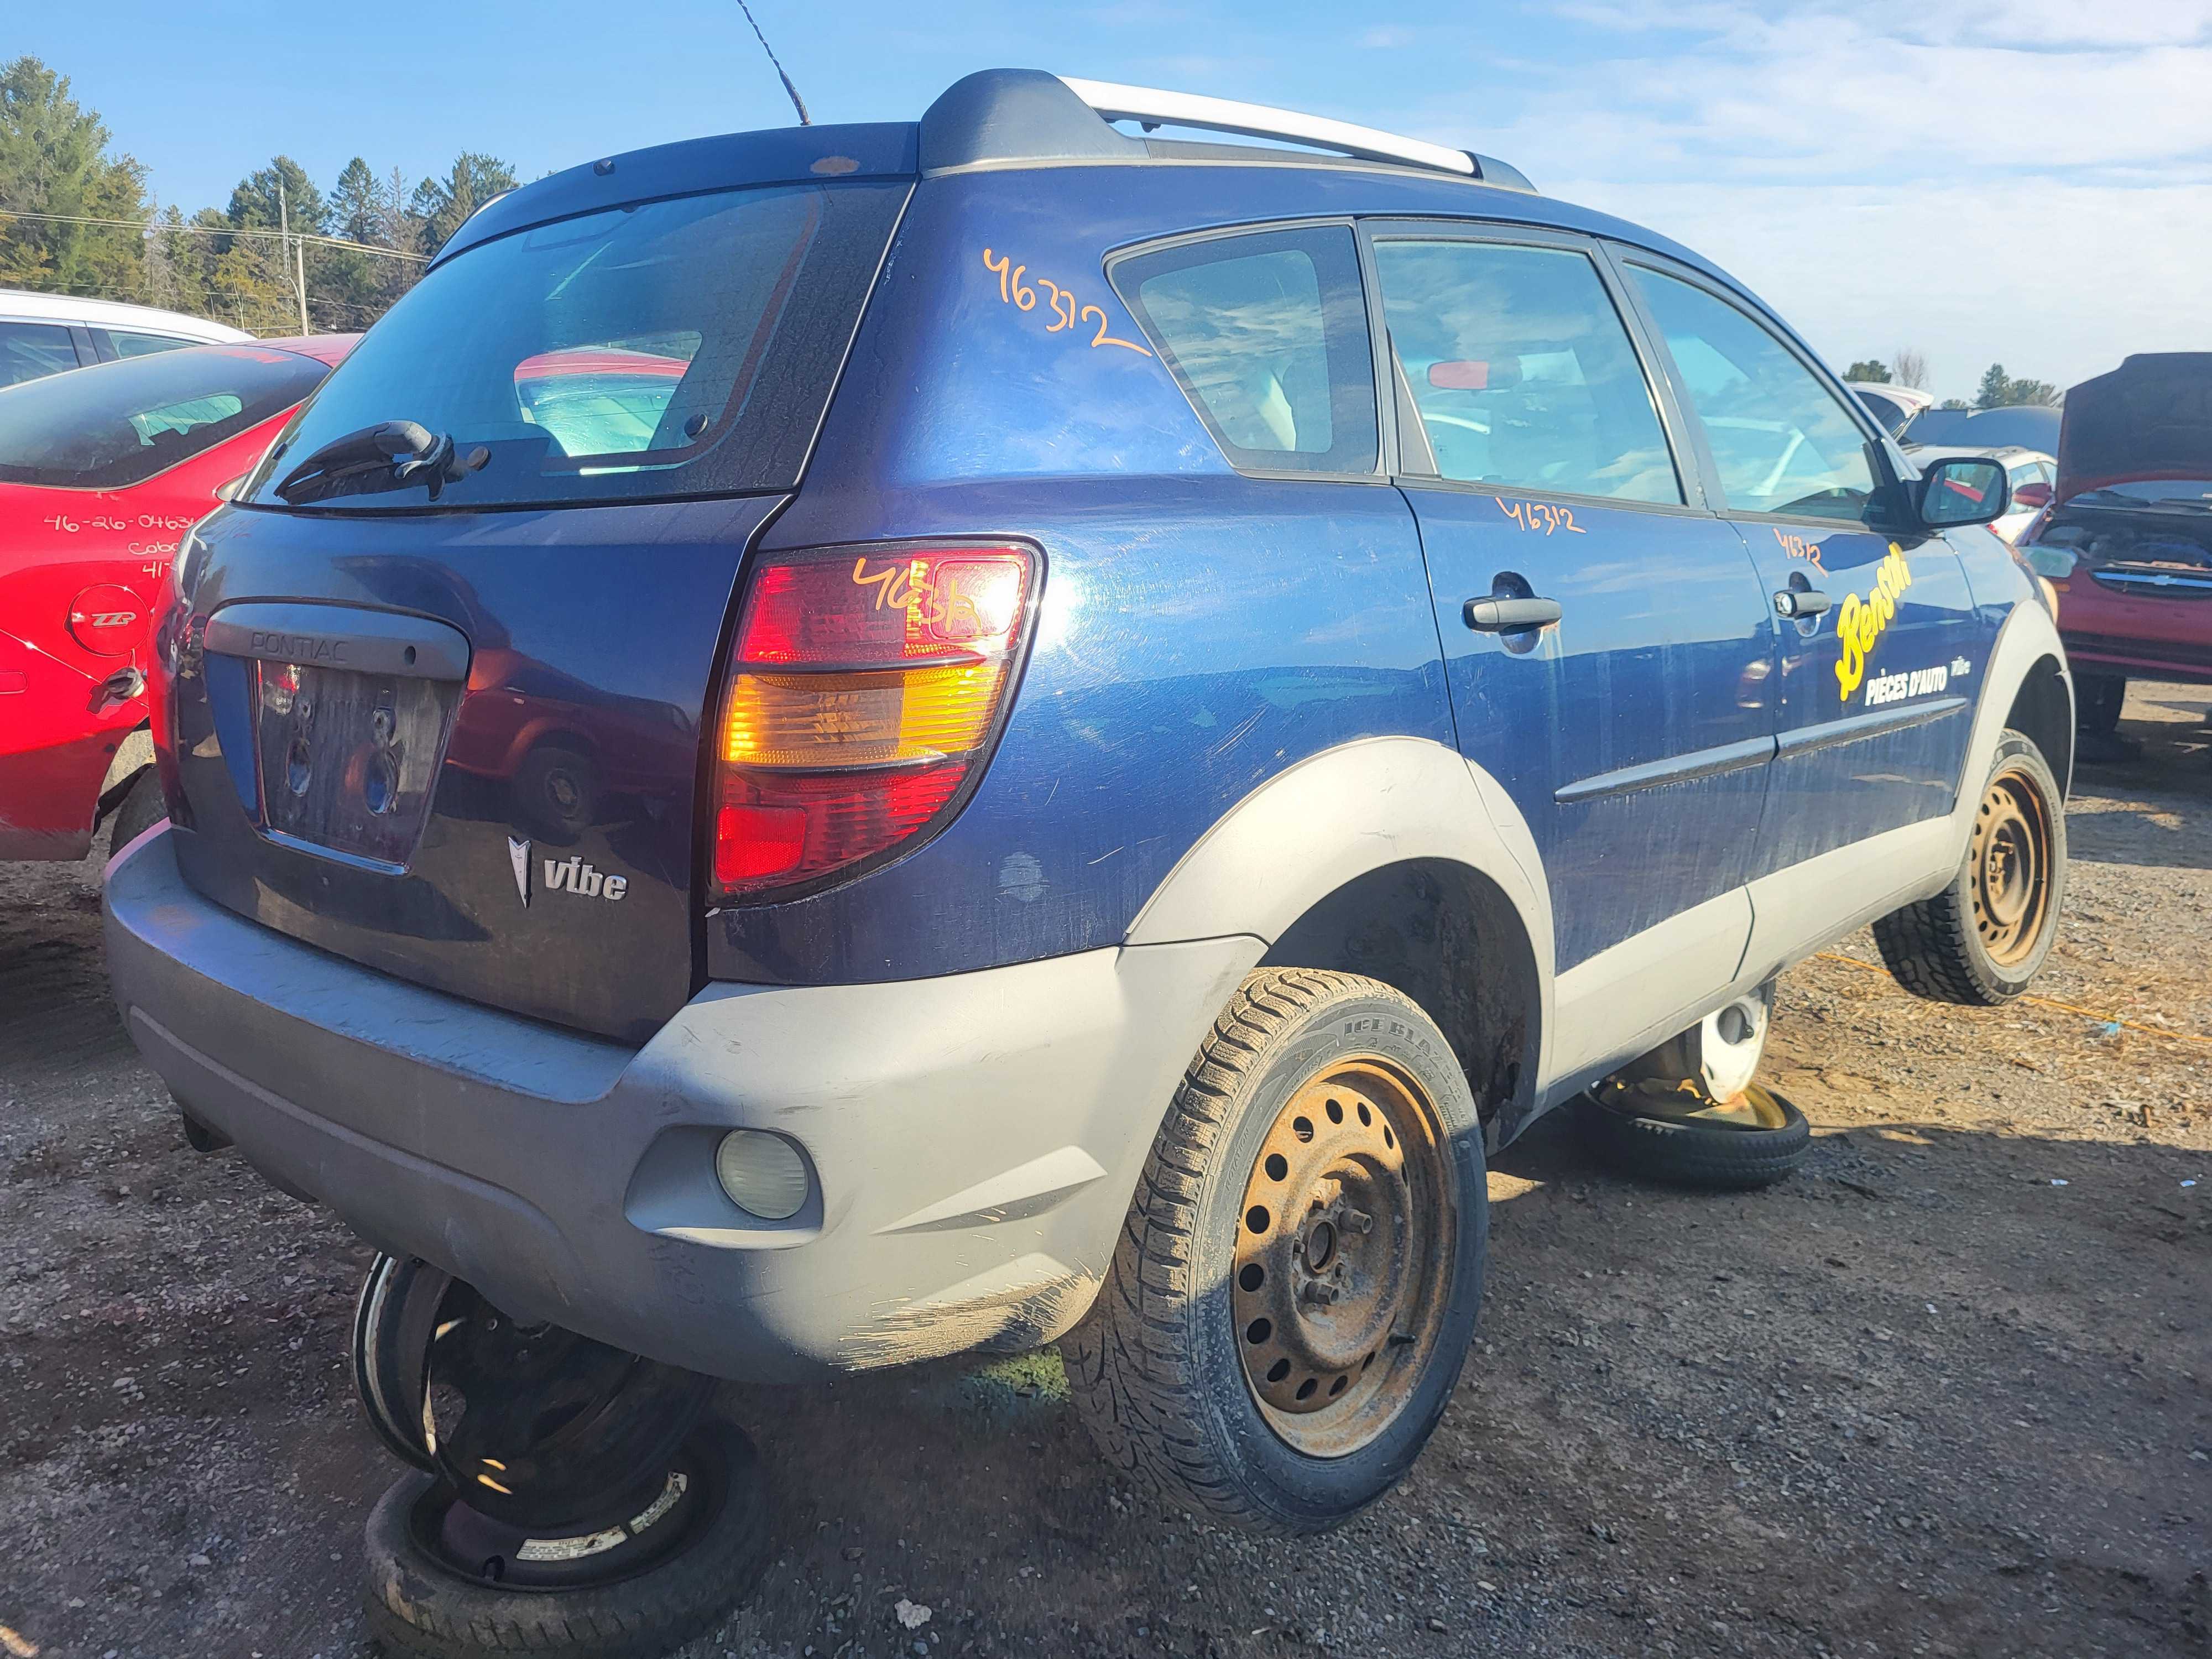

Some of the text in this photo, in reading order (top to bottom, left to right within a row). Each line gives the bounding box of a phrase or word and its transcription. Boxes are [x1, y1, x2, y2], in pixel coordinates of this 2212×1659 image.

[251, 632, 349, 662] PONTIAC
[1865, 667, 1908, 706] PIÈCES
[1908, 665, 1948, 697] D'AUTO
[544, 855, 628, 901] vibe
